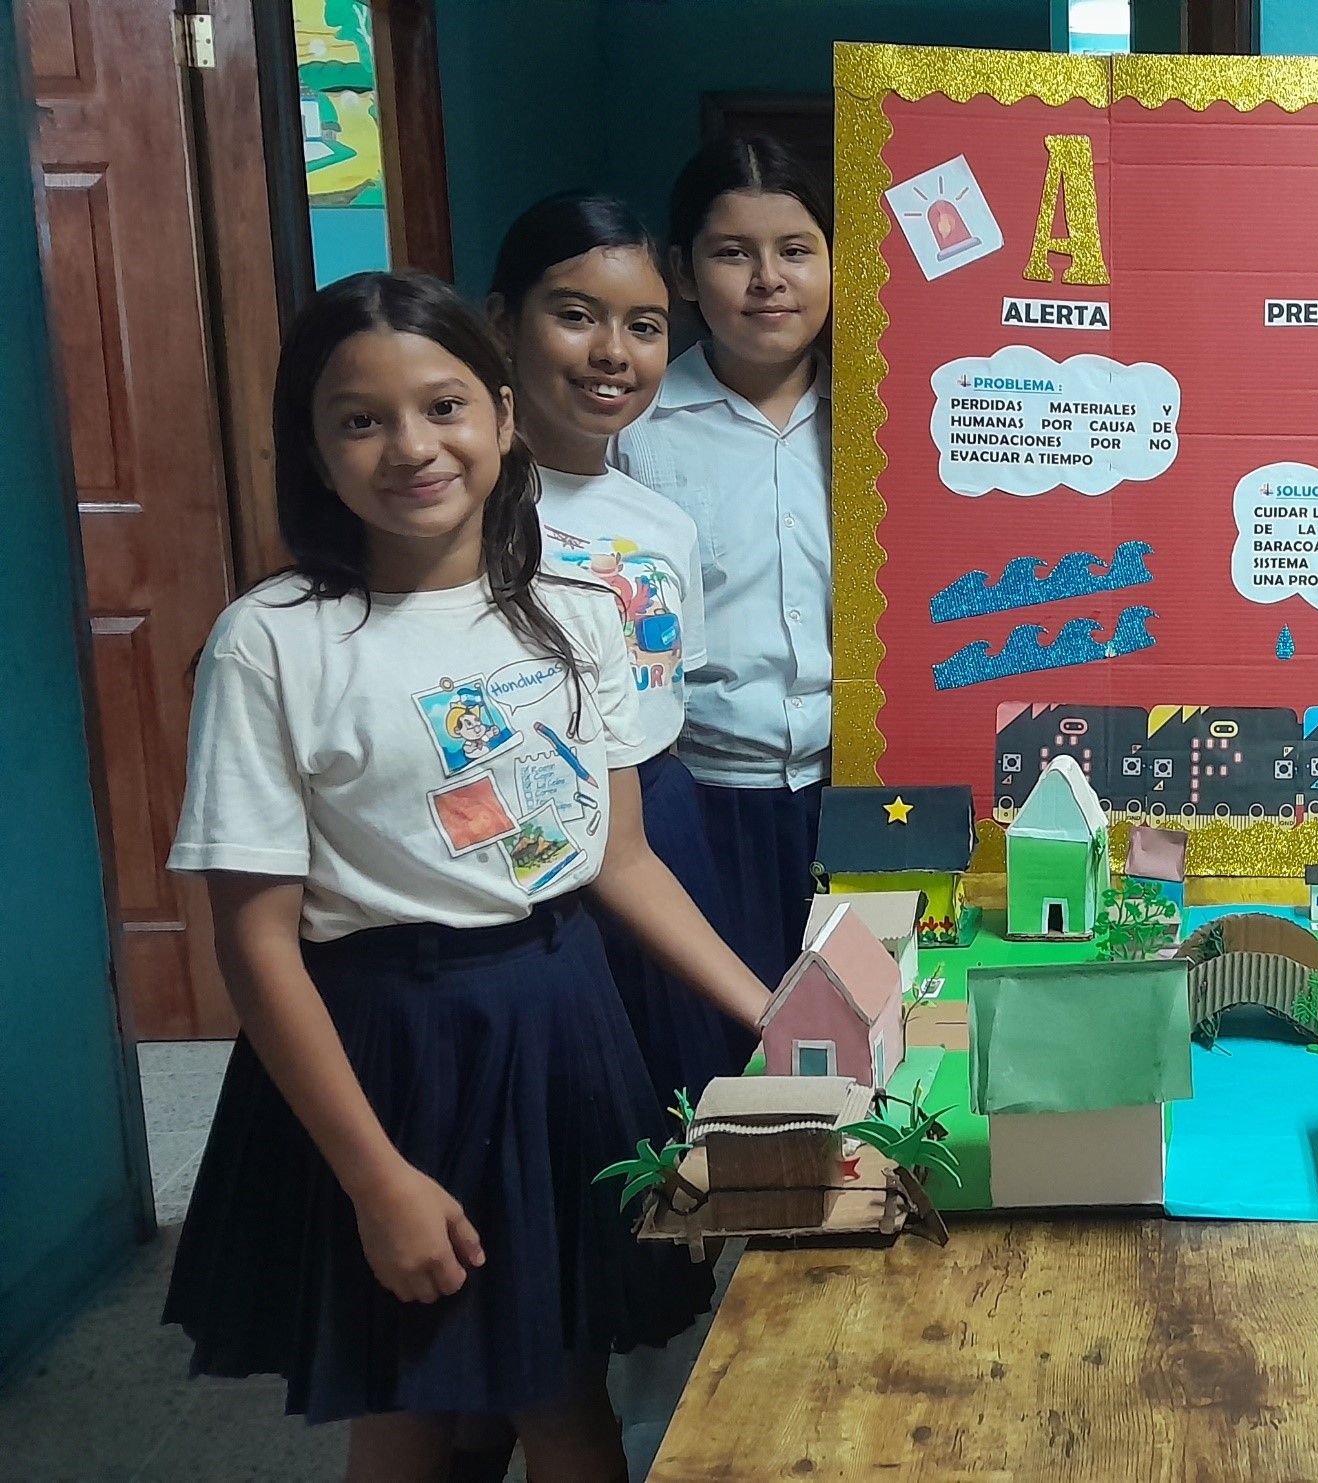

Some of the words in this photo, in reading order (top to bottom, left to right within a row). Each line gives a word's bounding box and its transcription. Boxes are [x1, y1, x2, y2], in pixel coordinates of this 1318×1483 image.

[1022, 135, 1110, 286] A
[1003, 301, 1108, 328] ALERTA
[974, 377, 1055, 392] PROBLEMA
[951, 398, 1023, 412] PERDIDAS
[1050, 402, 1136, 416] MATERIALES
[1163, 405, 1172, 416] Y
[951, 416, 1024, 430] HUMANAS
[1042, 419, 1072, 431] POR
[1089, 420, 1136, 433] CAUSA
[1153, 422, 1172, 433] DE
[951, 433, 1062, 447] INUNDACIONES
[1091, 437, 1121, 449] POR
[1150, 439, 1172, 450] NO
[950, 450, 1020, 464] EVACUAR
[1024, 452, 1034, 464] A
[1038, 453, 1093, 466] TIEMPO
[1254, 506, 1308, 519] CUIDAR
[1254, 524, 1273, 535] DE
[1298, 524, 1316, 535] LA
[1253, 557, 1308, 569] SISTEMA
[1253, 574, 1284, 586] UNA
